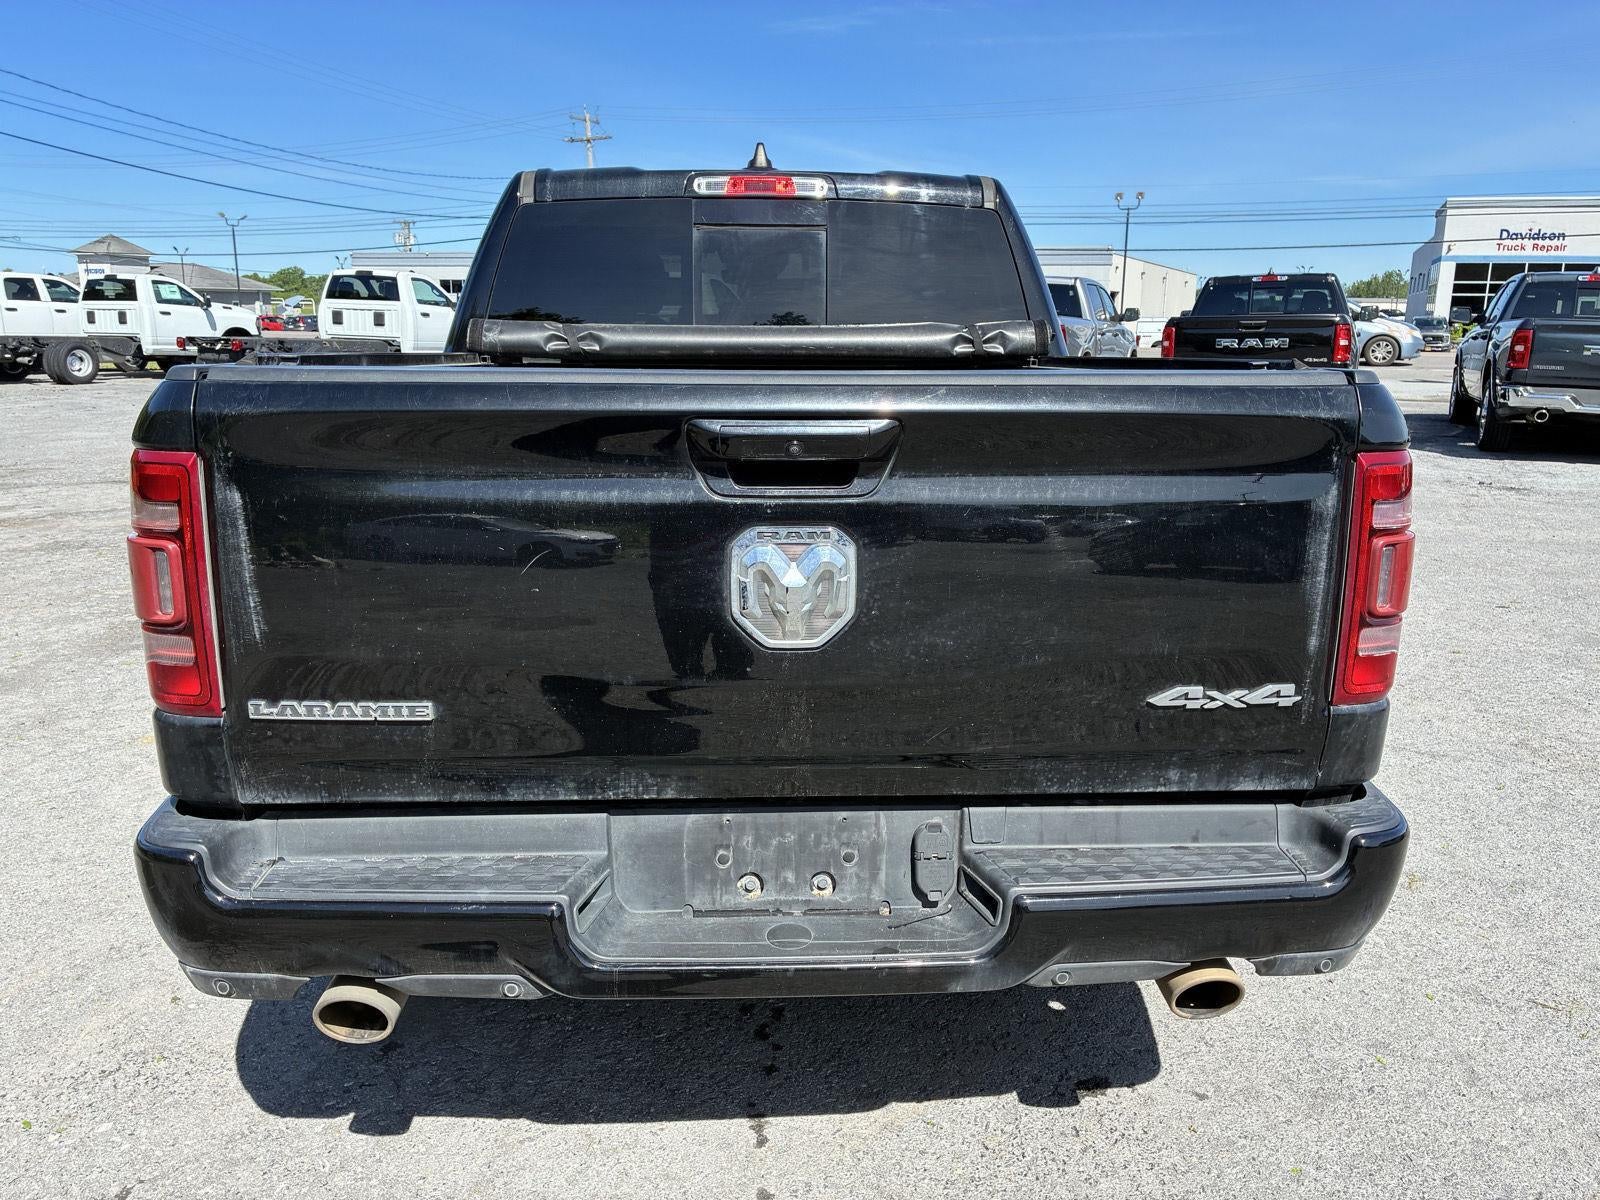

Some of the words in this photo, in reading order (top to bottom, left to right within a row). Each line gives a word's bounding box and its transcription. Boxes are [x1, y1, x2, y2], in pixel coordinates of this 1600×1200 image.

[1499, 228, 1566, 241] Davidson
[1496, 243, 1526, 252] Truck
[1532, 243, 1567, 253] Repair
[1216, 338, 1289, 348] RAM
[757, 531, 831, 540] RAM
[248, 701, 435, 721] LARAMIE
